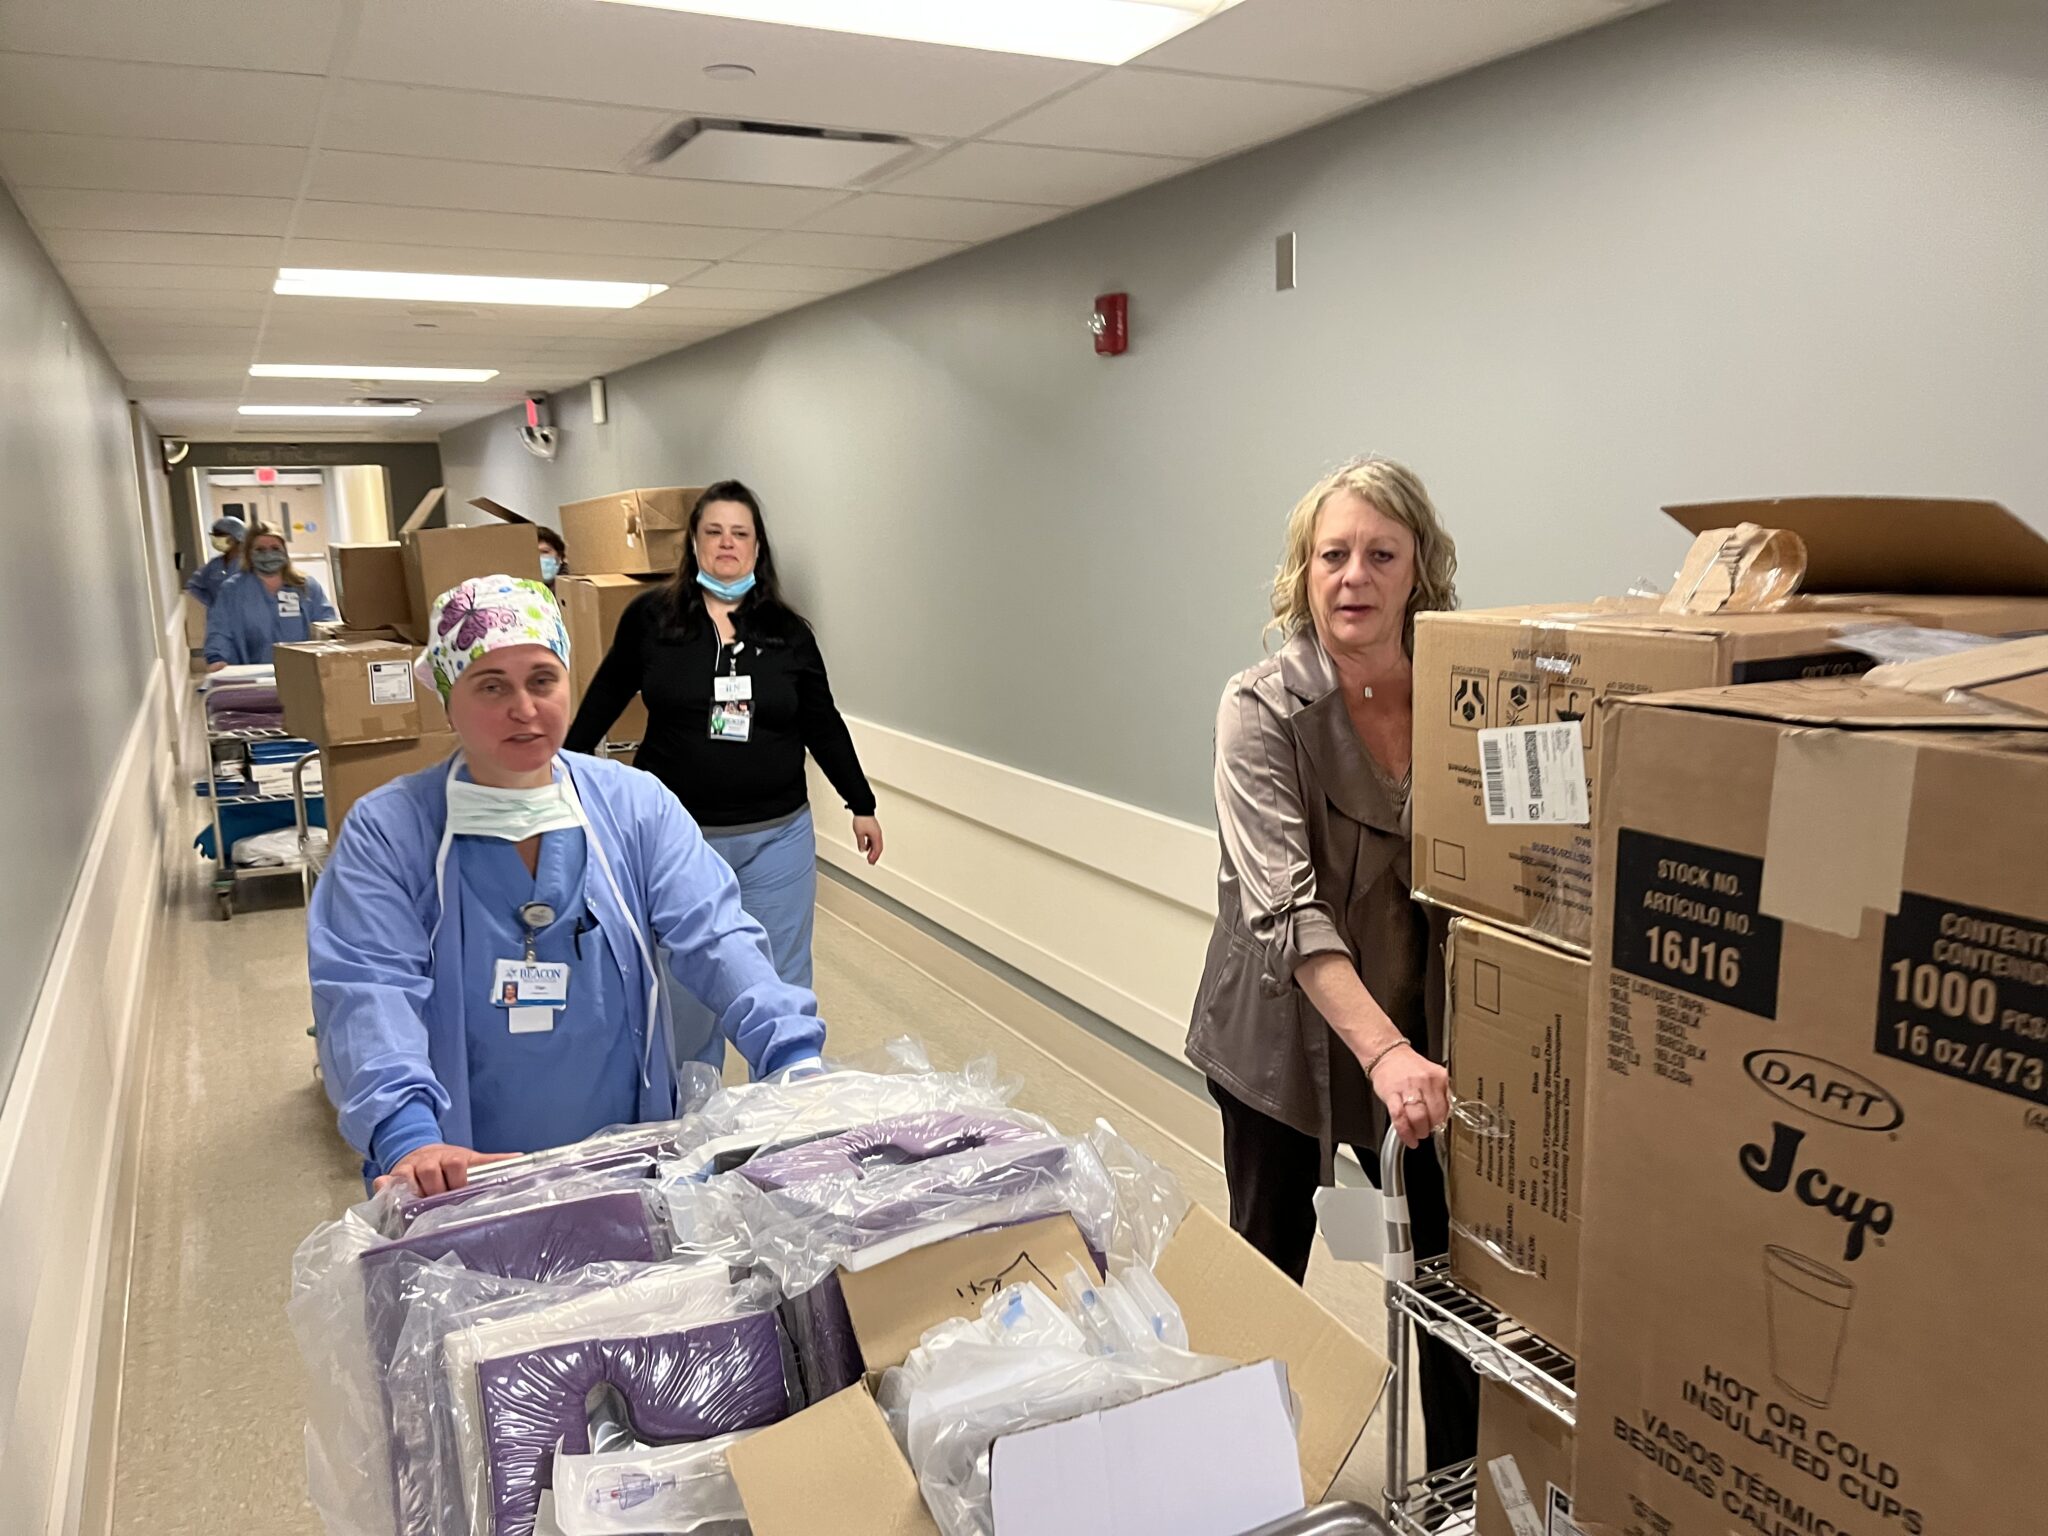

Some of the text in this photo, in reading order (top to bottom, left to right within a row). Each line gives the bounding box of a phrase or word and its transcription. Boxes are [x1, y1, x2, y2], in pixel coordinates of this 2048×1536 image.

[1657, 858, 1743, 897] STOCK NO.
[1643, 889, 1755, 936] ARTÍCULO NO.
[520, 969, 561, 979] BEACON
[1646, 925, 1741, 988] 16J16
[1891, 957, 1998, 1026] 1000
[1554, 1013, 1562, 1079] Development
[1893, 1019, 1931, 1056] 16
[1532, 1072, 1540, 1094] Blue
[1563, 1078, 1571, 1107] China
[1761, 1059, 1883, 1117] DART
[1553, 1080, 1562, 1148] Technological
[1530, 1178, 1538, 1206] White
[1681, 1379, 1924, 1535] INSULATED CUPS
[1703, 1364, 1900, 1490] HOT OR COLD
[1612, 1416, 1716, 1500] BEBIDAS
[1642, 1408, 1726, 1477] VASOS
[1731, 1465, 1851, 1536] TÉRMIC
